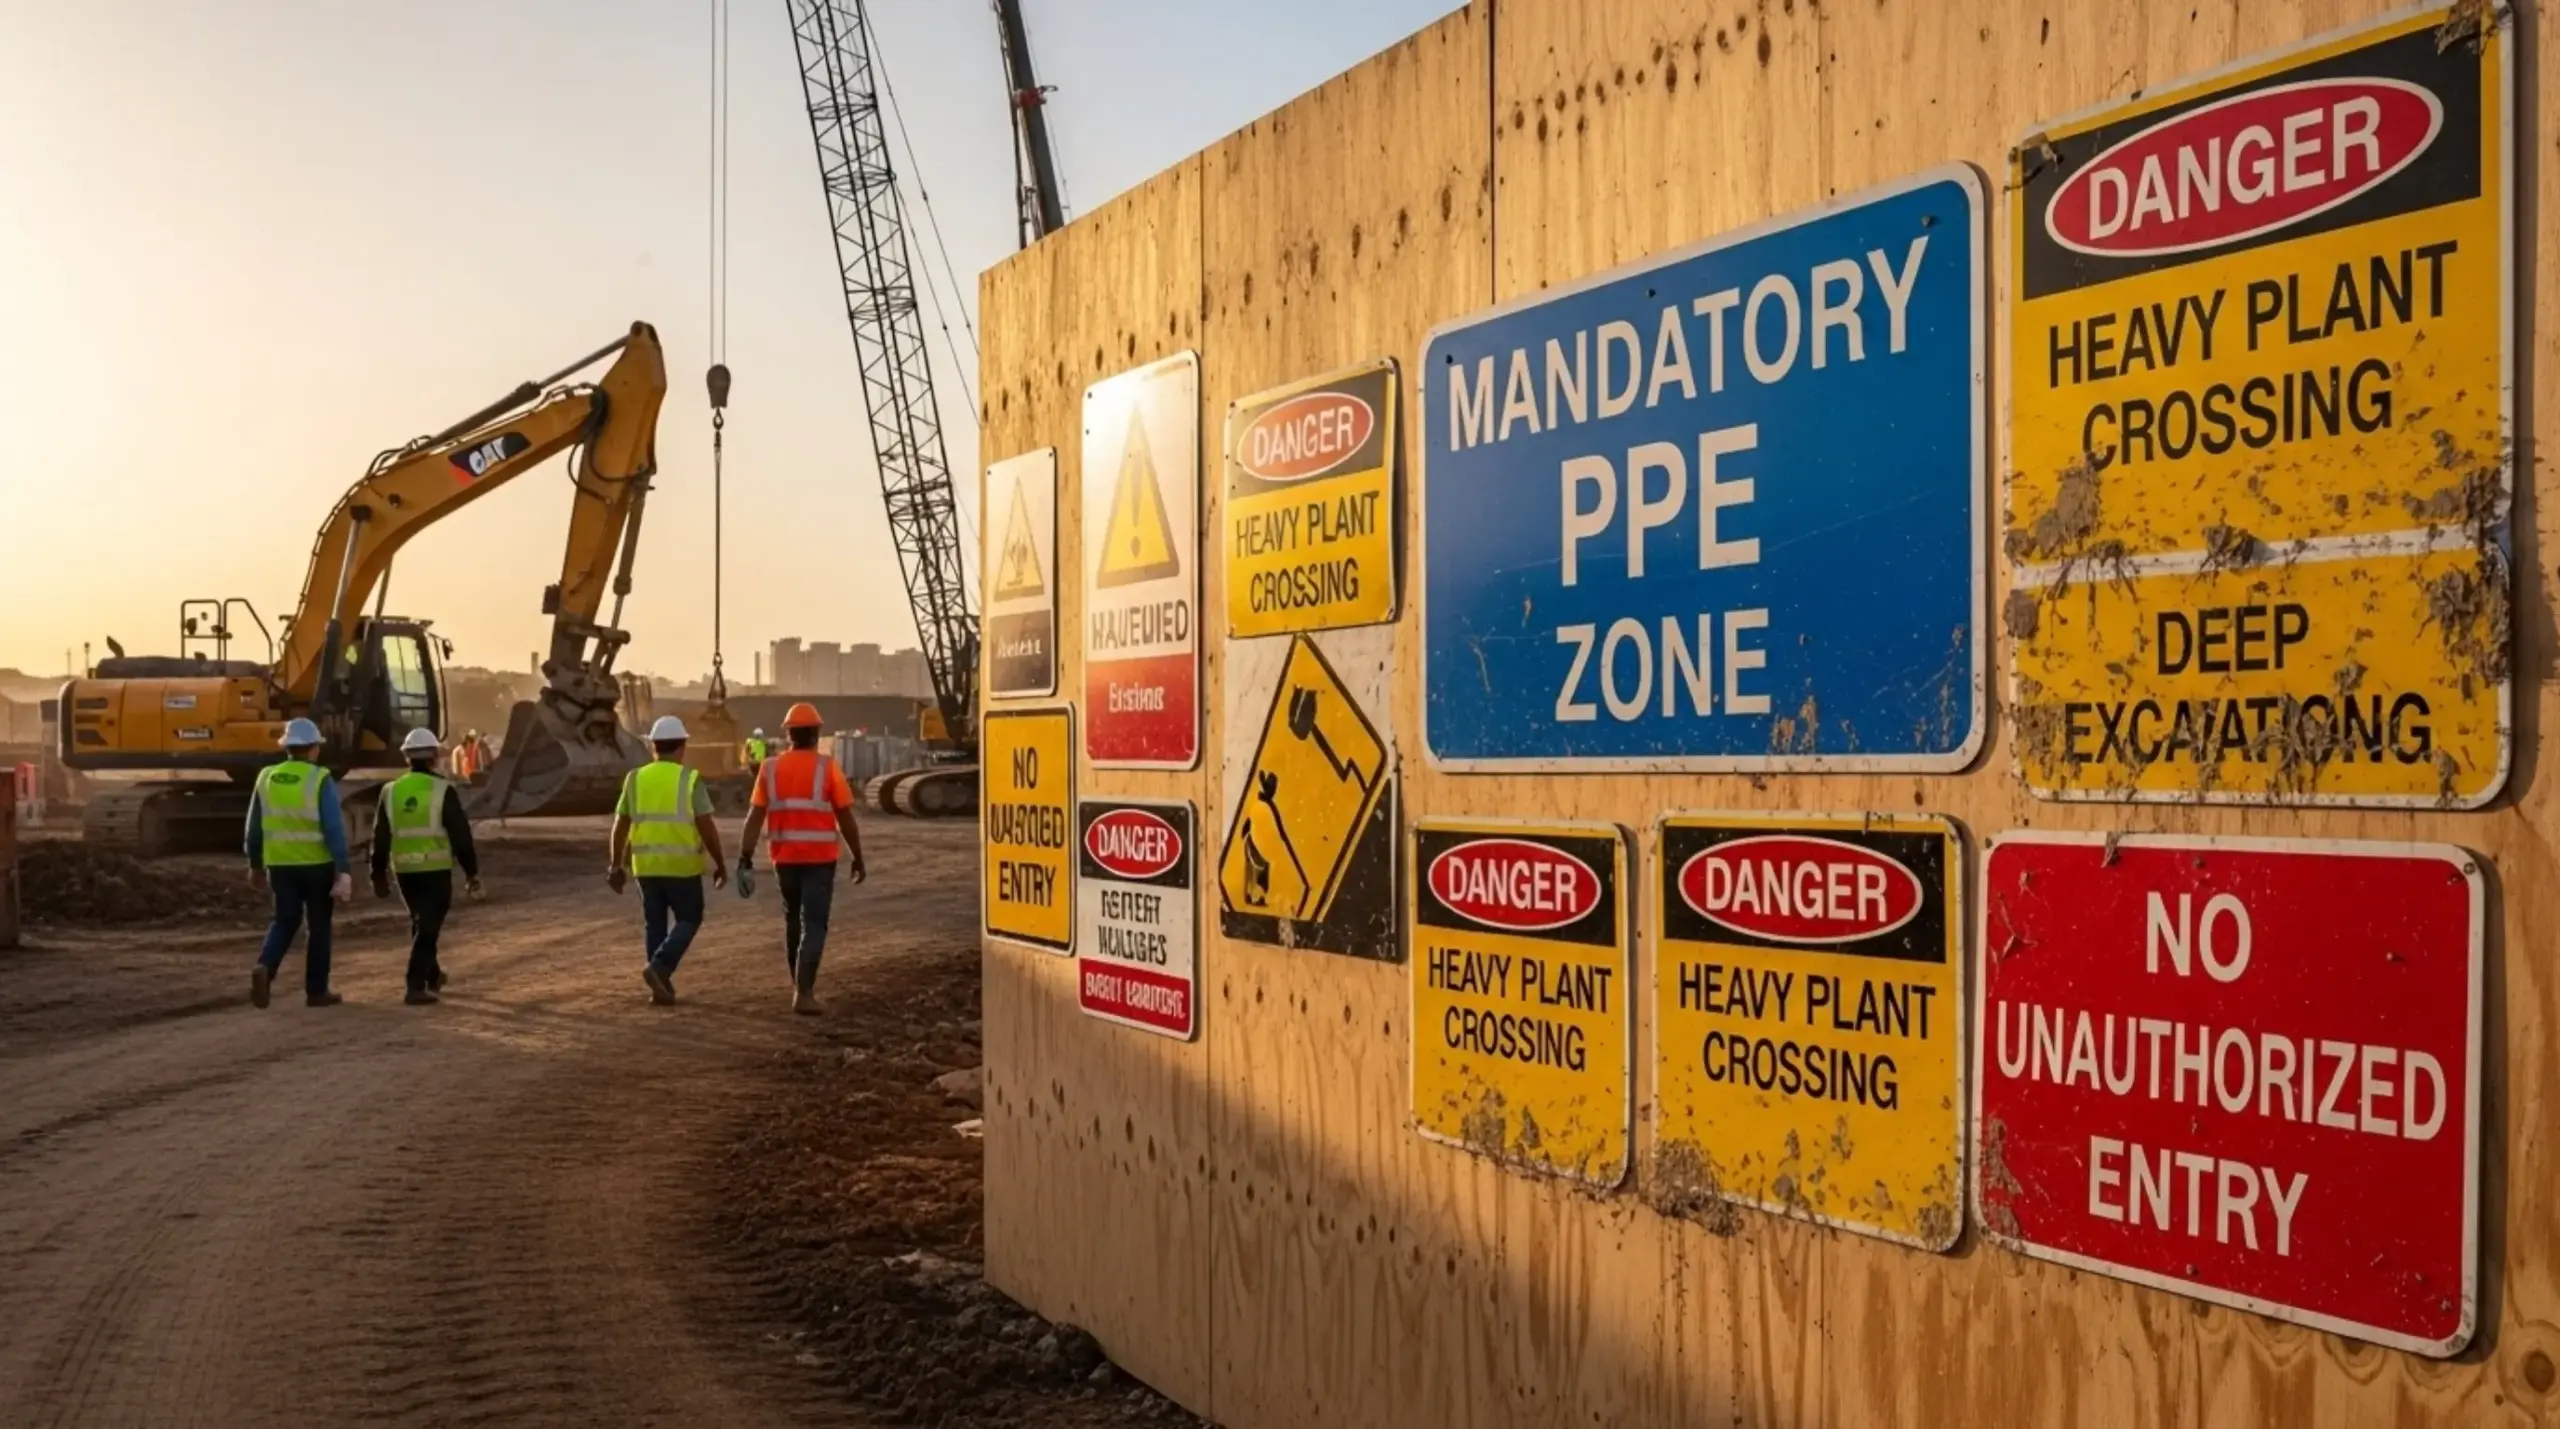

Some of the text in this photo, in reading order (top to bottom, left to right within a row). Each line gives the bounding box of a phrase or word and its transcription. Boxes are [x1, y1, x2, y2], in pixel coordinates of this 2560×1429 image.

[2089, 96, 2381, 240] DANGER
[1449, 234, 1930, 452] MANDATORY
[2050, 239, 2458, 388] HEAVY PLANT
[1253, 405, 1354, 468] DANGER
[2083, 358, 2392, 471] CROSSING
[1236, 490, 1380, 559] HEAVY PLANT
[1561, 423, 1760, 587] PPE
[1250, 557, 1360, 614] CROSSING
[1554, 608, 1771, 722] ZONE
[2157, 603, 2310, 675] DEEP
[1013, 746, 1038, 790] NO
[1097, 823, 1169, 862] DANGER
[998, 860, 1056, 908] ENTRY
[1448, 856, 1578, 913] DANGER
[1705, 858, 1888, 922] DANGER
[2146, 891, 2252, 983] NO
[1428, 946, 1612, 1014] HEAVY PLANT
[1680, 962, 1936, 1040] HEAVY PLANT
[1444, 1006, 1586, 1072] CROSSING
[1703, 1031, 1898, 1110] CROSSING
[1998, 1000, 2447, 1141] UNAUTHORIZED
[2089, 1135, 2308, 1257] ENTRY
